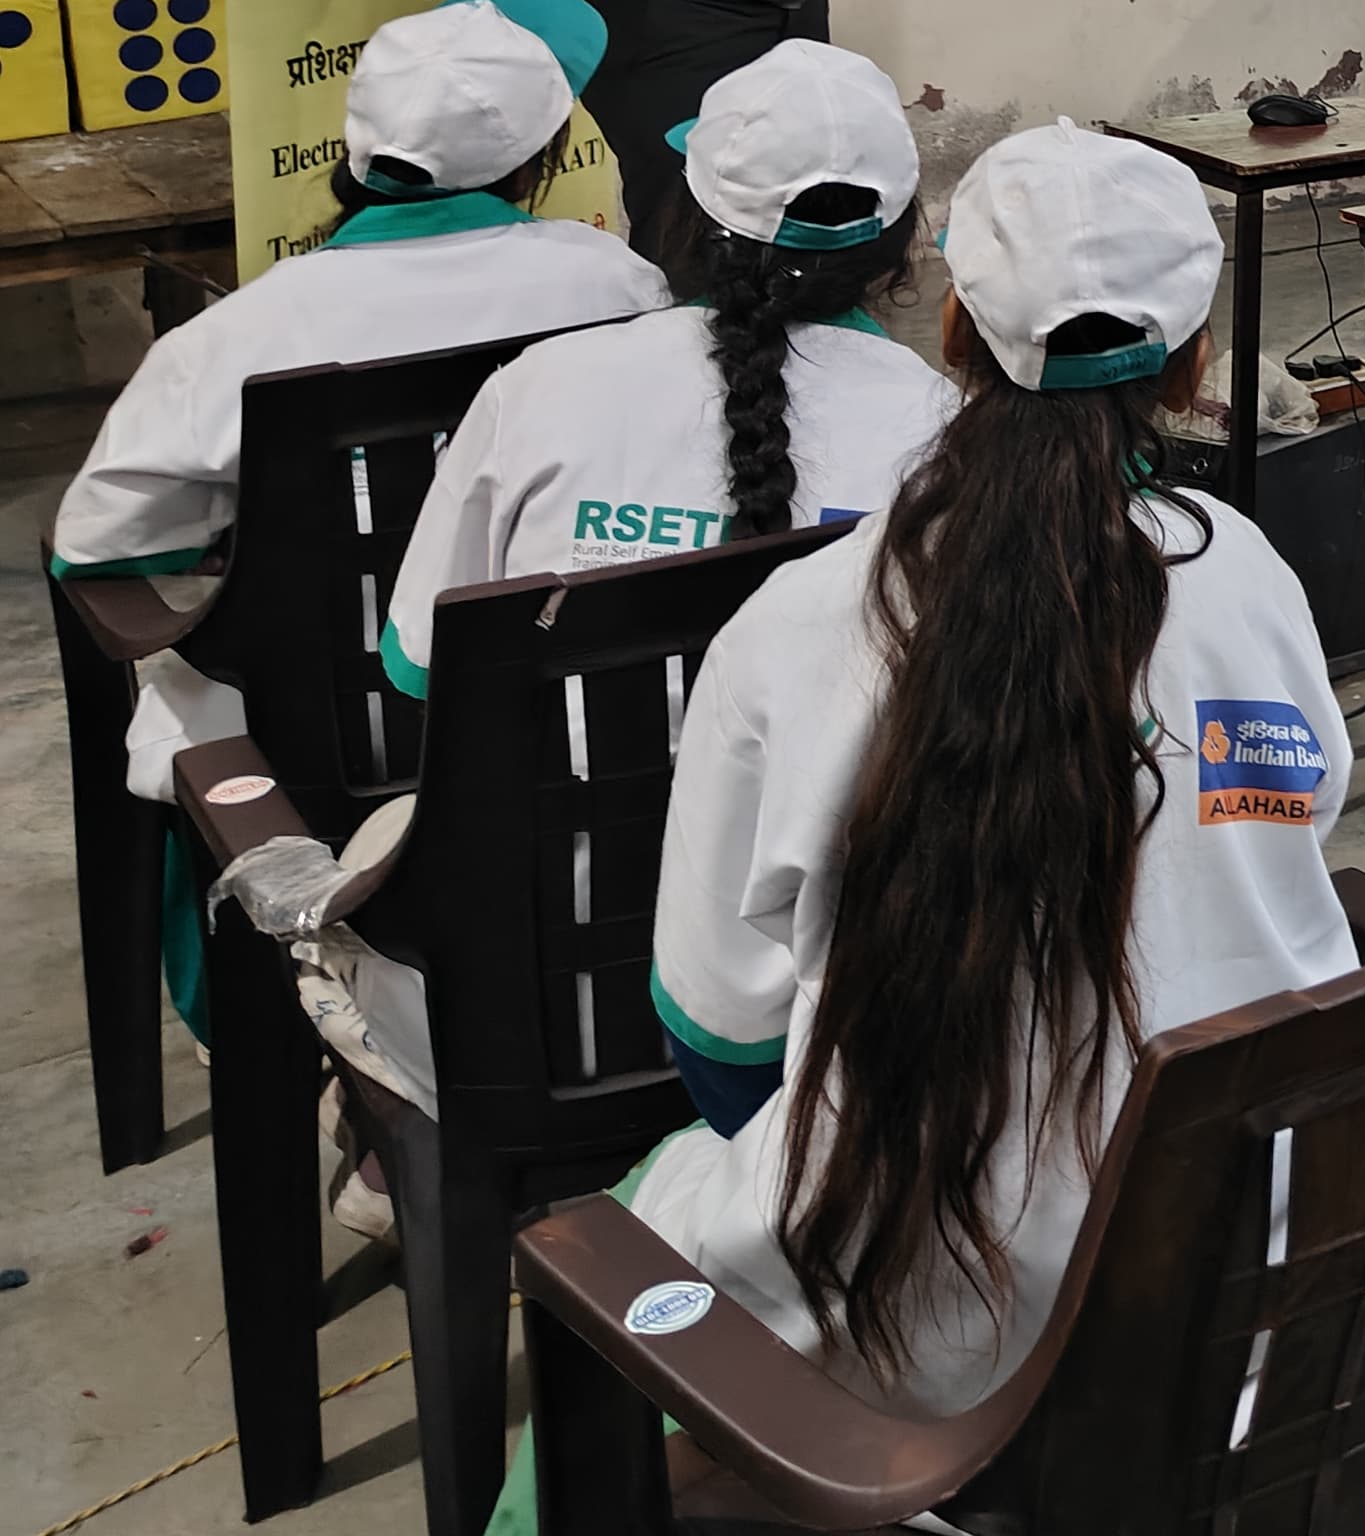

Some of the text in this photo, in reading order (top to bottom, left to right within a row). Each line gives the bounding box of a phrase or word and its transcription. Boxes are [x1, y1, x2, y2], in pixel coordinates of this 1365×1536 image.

[572, 543, 608, 556] Rural
[611, 544, 637, 559] Self
[1234, 740, 1295, 768] Indian
